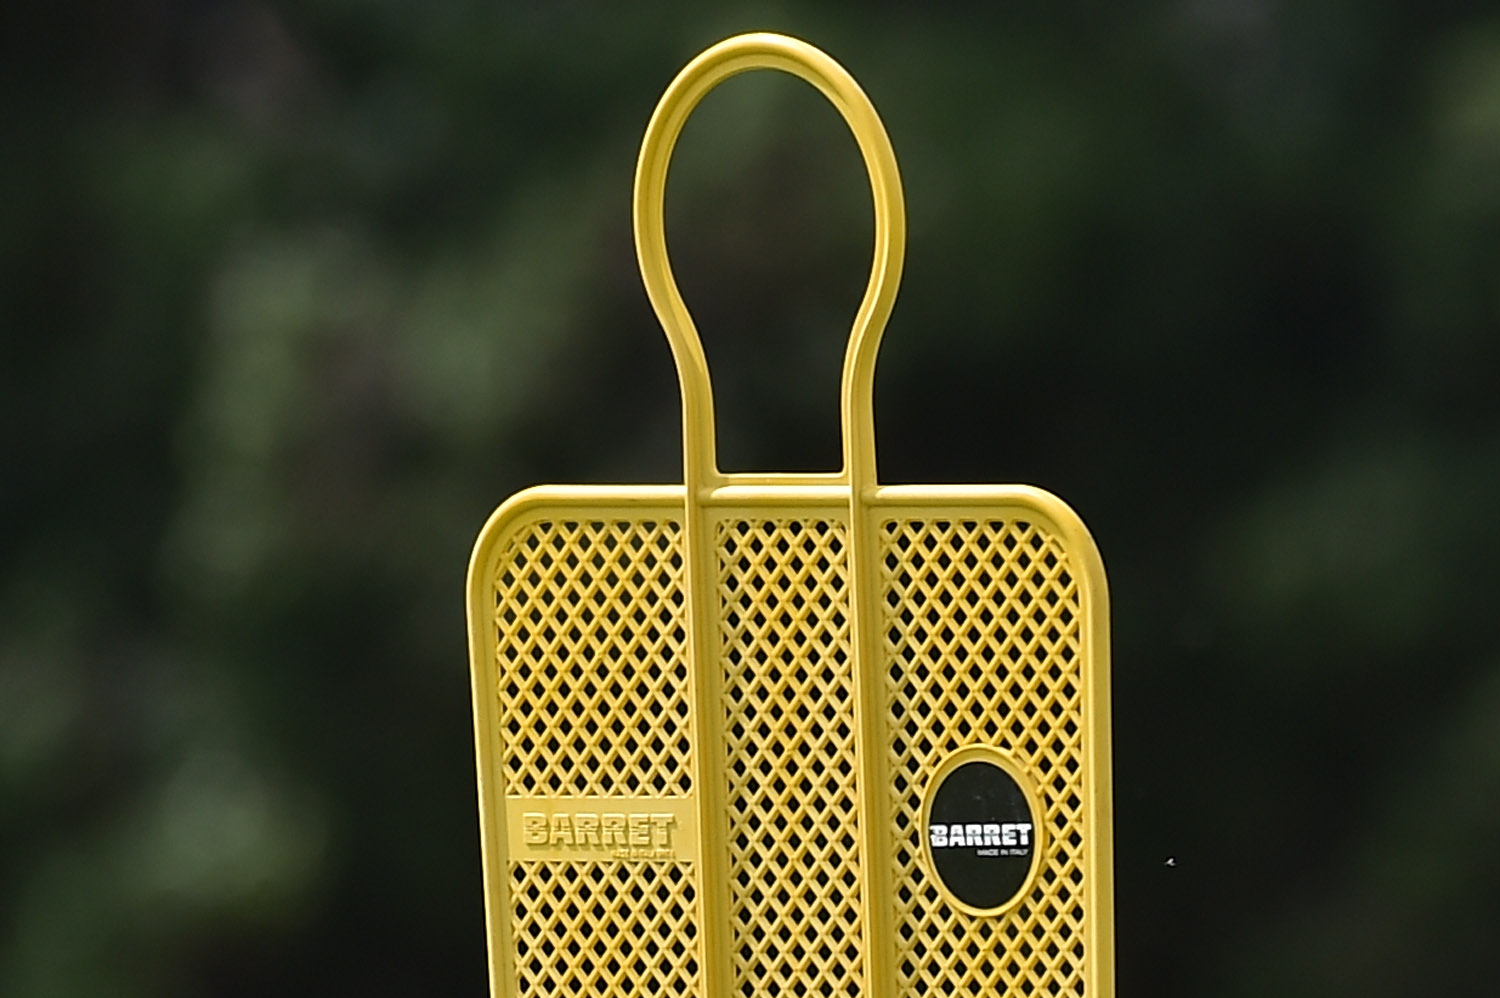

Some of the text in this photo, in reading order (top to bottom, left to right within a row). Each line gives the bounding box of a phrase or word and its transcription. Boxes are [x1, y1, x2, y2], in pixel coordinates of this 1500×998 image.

[523, 812, 677, 846] BARRET
[929, 823, 1032, 847] BARRET
[1000, 848, 1009, 856] IN
[1009, 848, 1029, 856] ITALY
